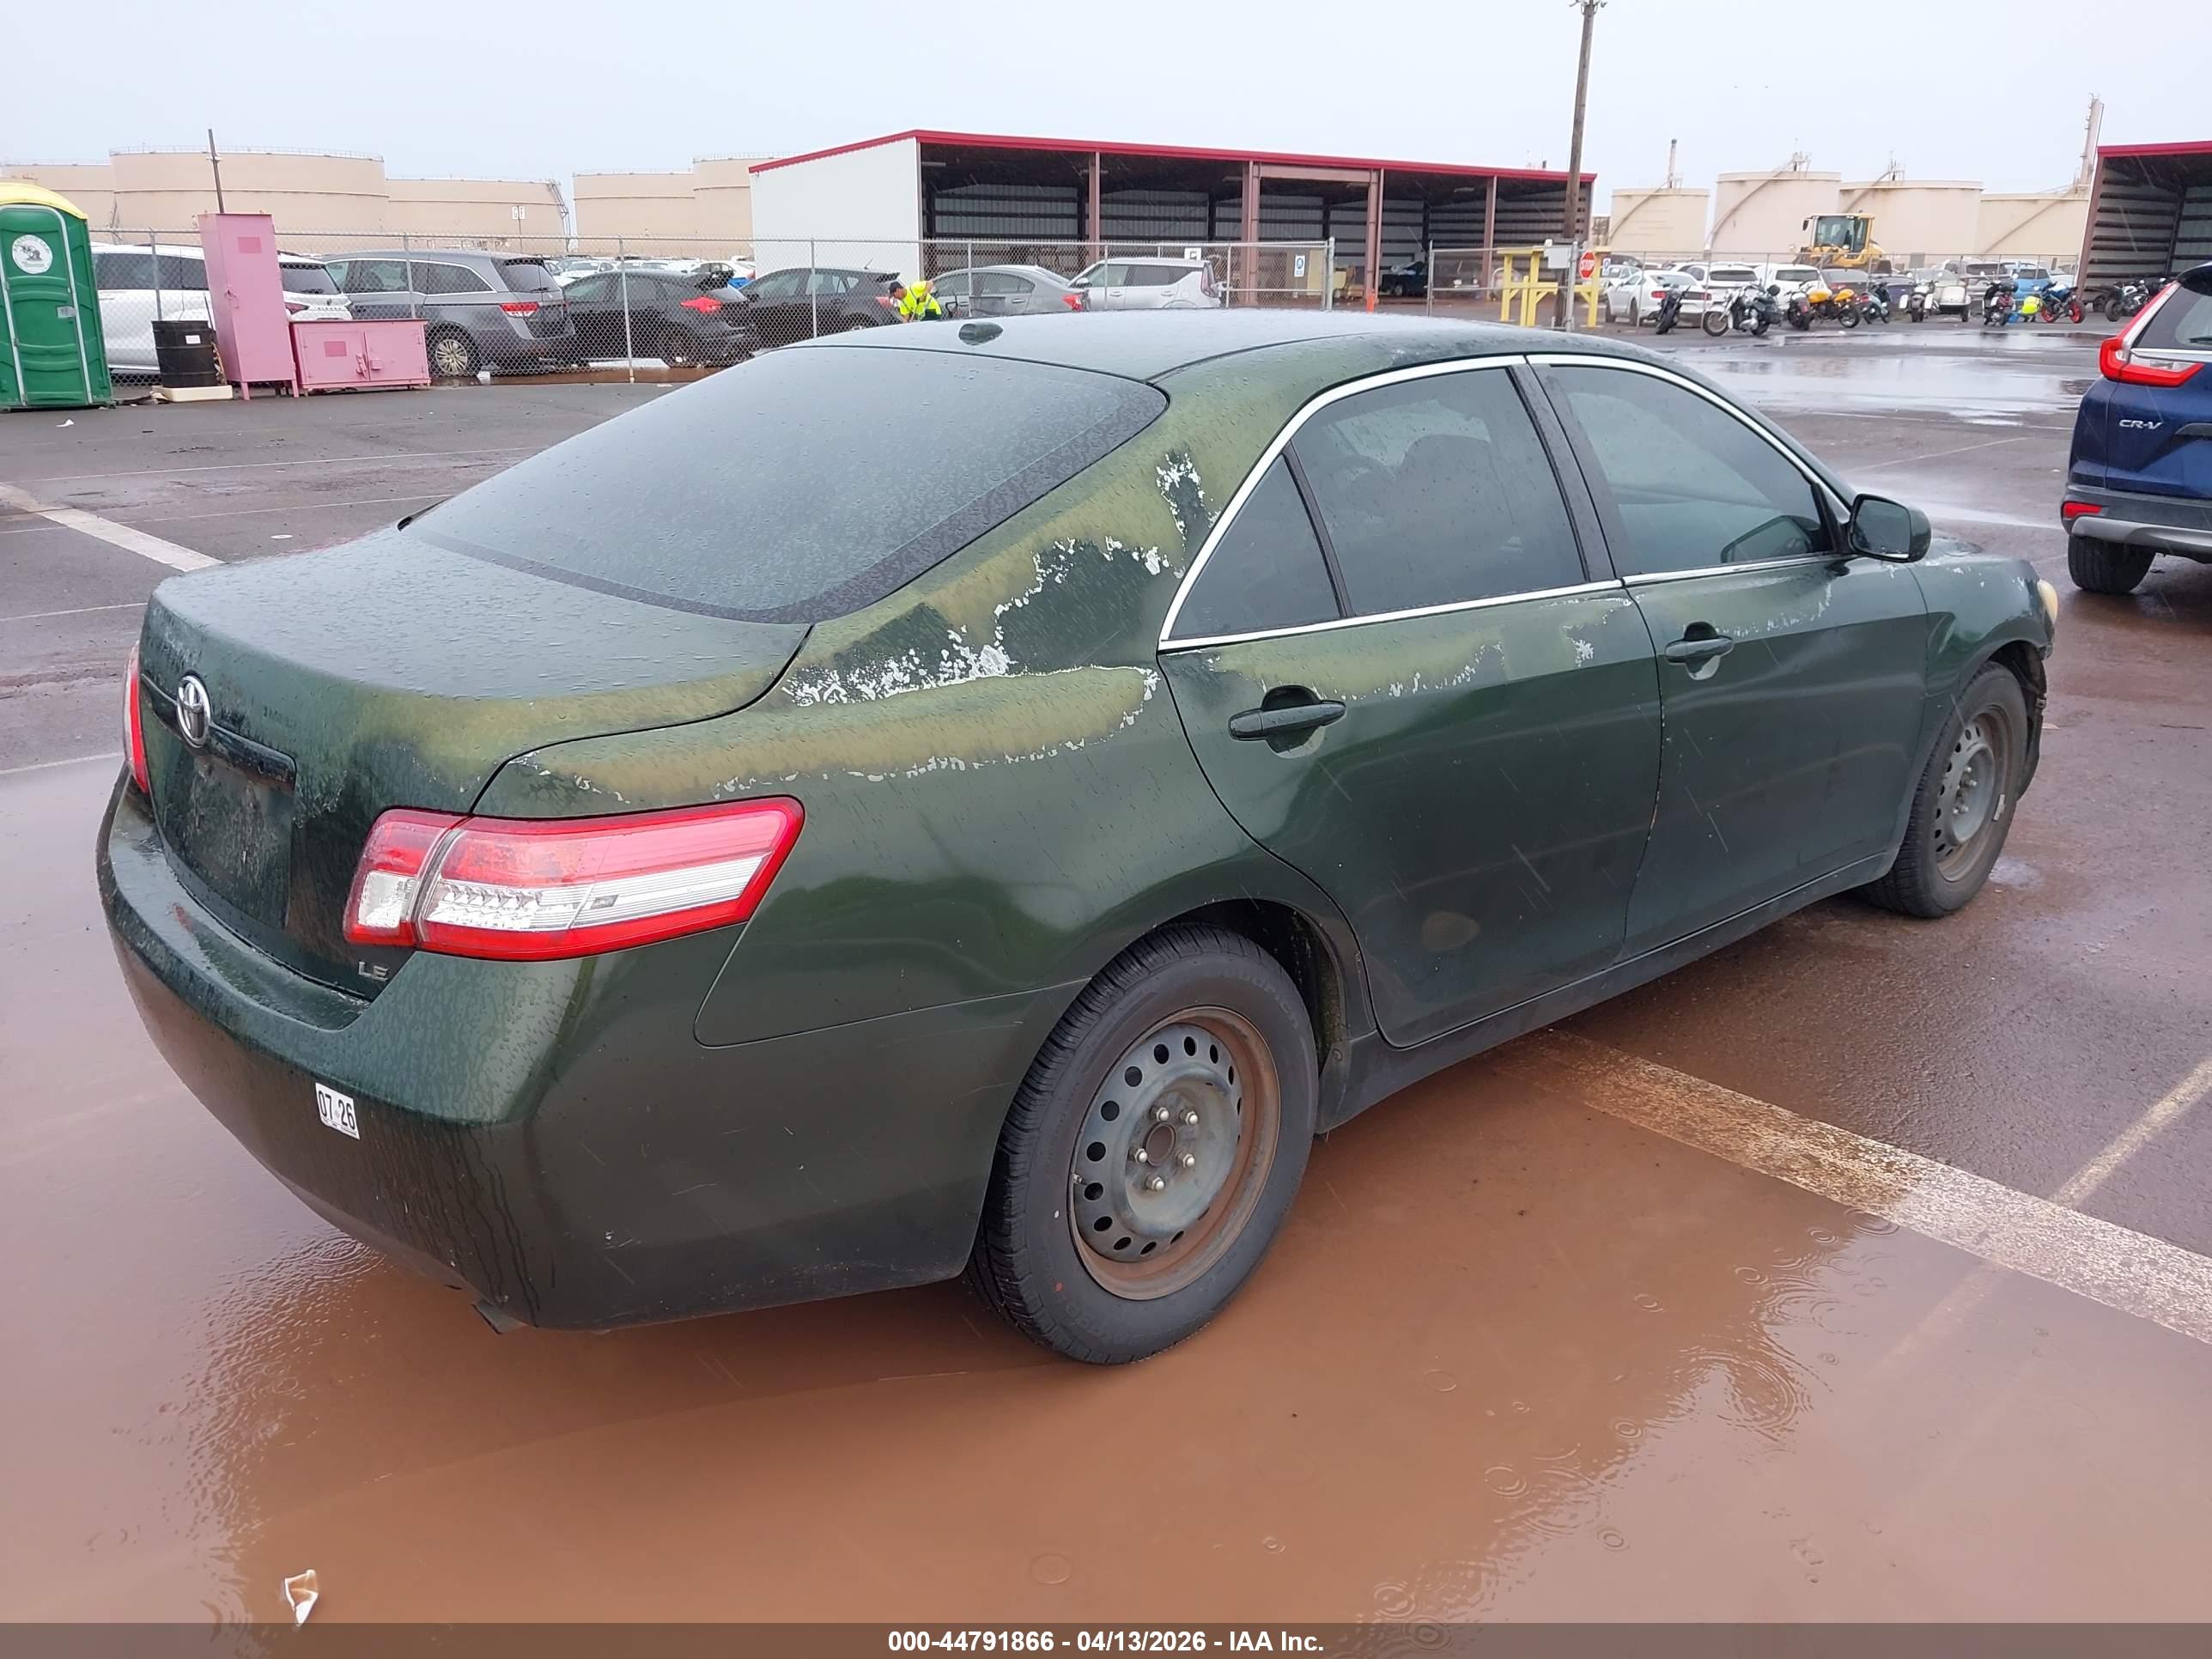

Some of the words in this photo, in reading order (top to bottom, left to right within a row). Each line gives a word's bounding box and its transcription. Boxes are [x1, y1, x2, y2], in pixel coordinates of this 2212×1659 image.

[1580, 259, 1595, 270] STOP
[2118, 419, 2163, 429] CR-V
[358, 961, 389, 982] LE
[319, 1090, 333, 1121] 07
[337, 1098, 356, 1130] 26
